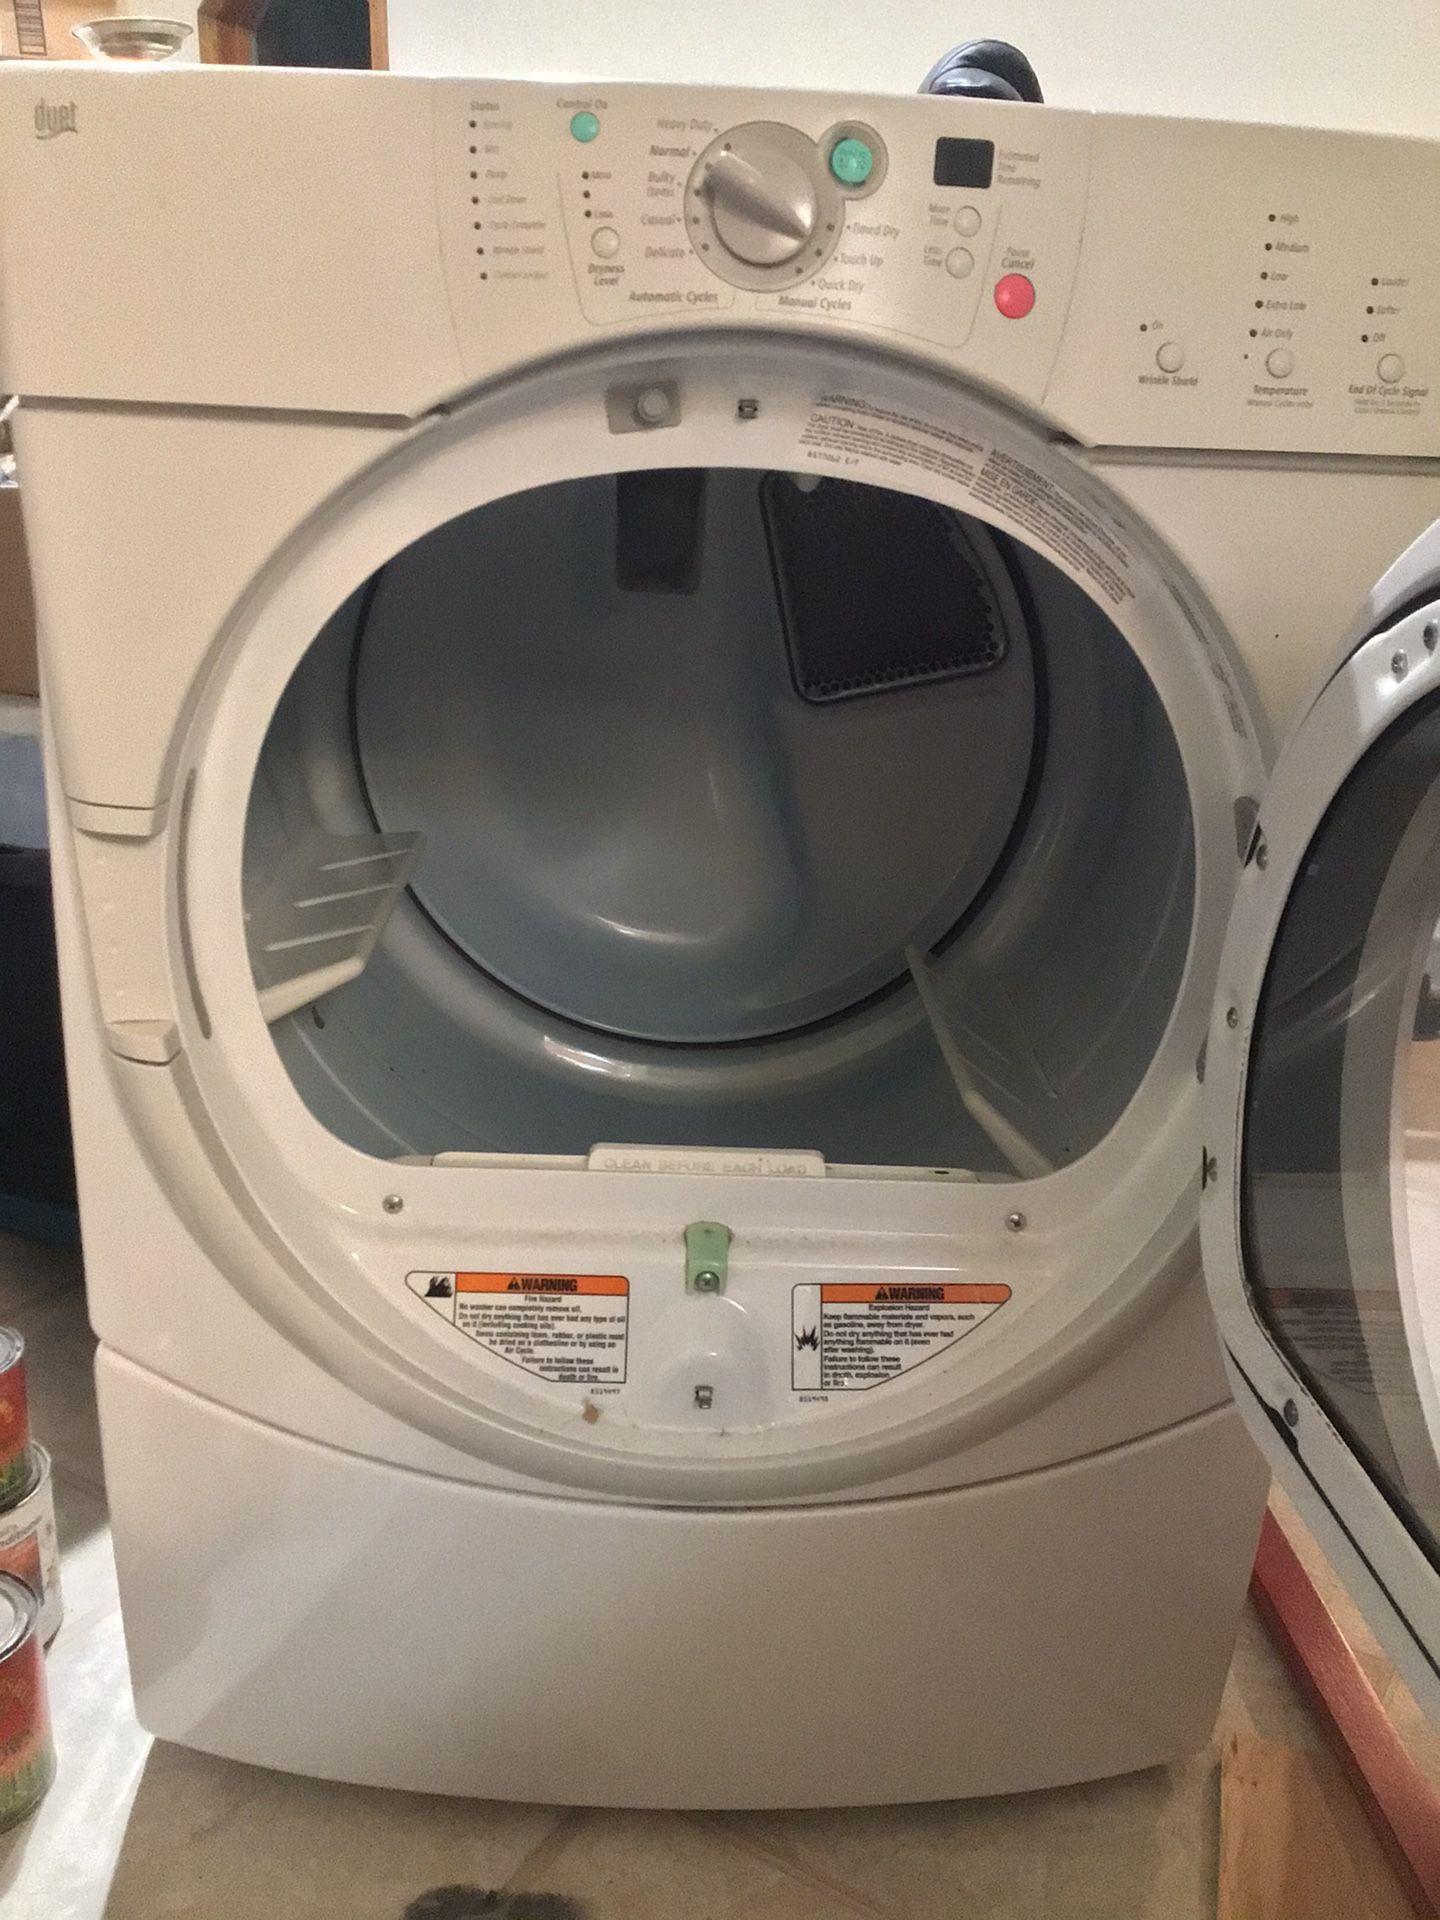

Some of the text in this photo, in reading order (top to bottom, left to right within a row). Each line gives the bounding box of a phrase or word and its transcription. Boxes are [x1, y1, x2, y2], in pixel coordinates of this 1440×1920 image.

[557, 99, 608, 110] Control On
[657, 119, 713, 131] Heavy Duty
[649, 146, 691, 157] Normal
[648, 172, 674, 183] Bulky
[641, 215, 675, 225] Casual
[929, 215, 949, 226] Time
[1280, 214, 1299, 225] High
[852, 223, 900, 240] Timed Dry
[645, 247, 685, 258] Delicate
[1275, 242, 1310, 253] Medium
[840, 254, 884, 268] Touch Up
[1001, 258, 1035, 271] Cancel
[588, 264, 625, 275] Dryness
[594, 276, 619, 286] Level
[1271, 272, 1288, 281] Low
[818, 278, 864, 293] Quick Dry
[629, 291, 718, 305] Automatic Cycles
[778, 296, 852, 312] Manual Cycles
[1266, 300, 1306, 310] Extra Low
[1152, 320, 1164, 330] On
[1261, 329, 1293, 340] Air Only
[1373, 333, 1386, 342] Off
[1139, 375, 1198, 386] Wrinkle Shield
[1254, 385, 1308, 396] Temperature
[1348, 385, 1364, 395] End
[1378, 386, 1401, 397] Cycle
[1403, 387, 1428, 399] Signal
[819, 394, 866, 408] WARNING
[809, 413, 854, 428] CAUTION
[990, 448, 1054, 491] AVERTISSEMENT
[980, 467, 1038, 505] MISE EN GARDE
[604, 1158, 807, 1175] CLEAN BEFORE EACH LOAD
[521, 1278, 577, 1292] WARNING
[889, 1288, 944, 1300] WARNING
[869, 1304, 903, 1312] Explosion
[494, 1314, 521, 1322] anything
[930, 1314, 956, 1322] vapors,
[478, 1321, 511, 1329] (including
[905, 1321, 923, 1329] dryer.
[848, 1331, 860, 1339] dry
[534, 1339, 569, 1347] clothesline
[522, 1356, 544, 1364] Failure
